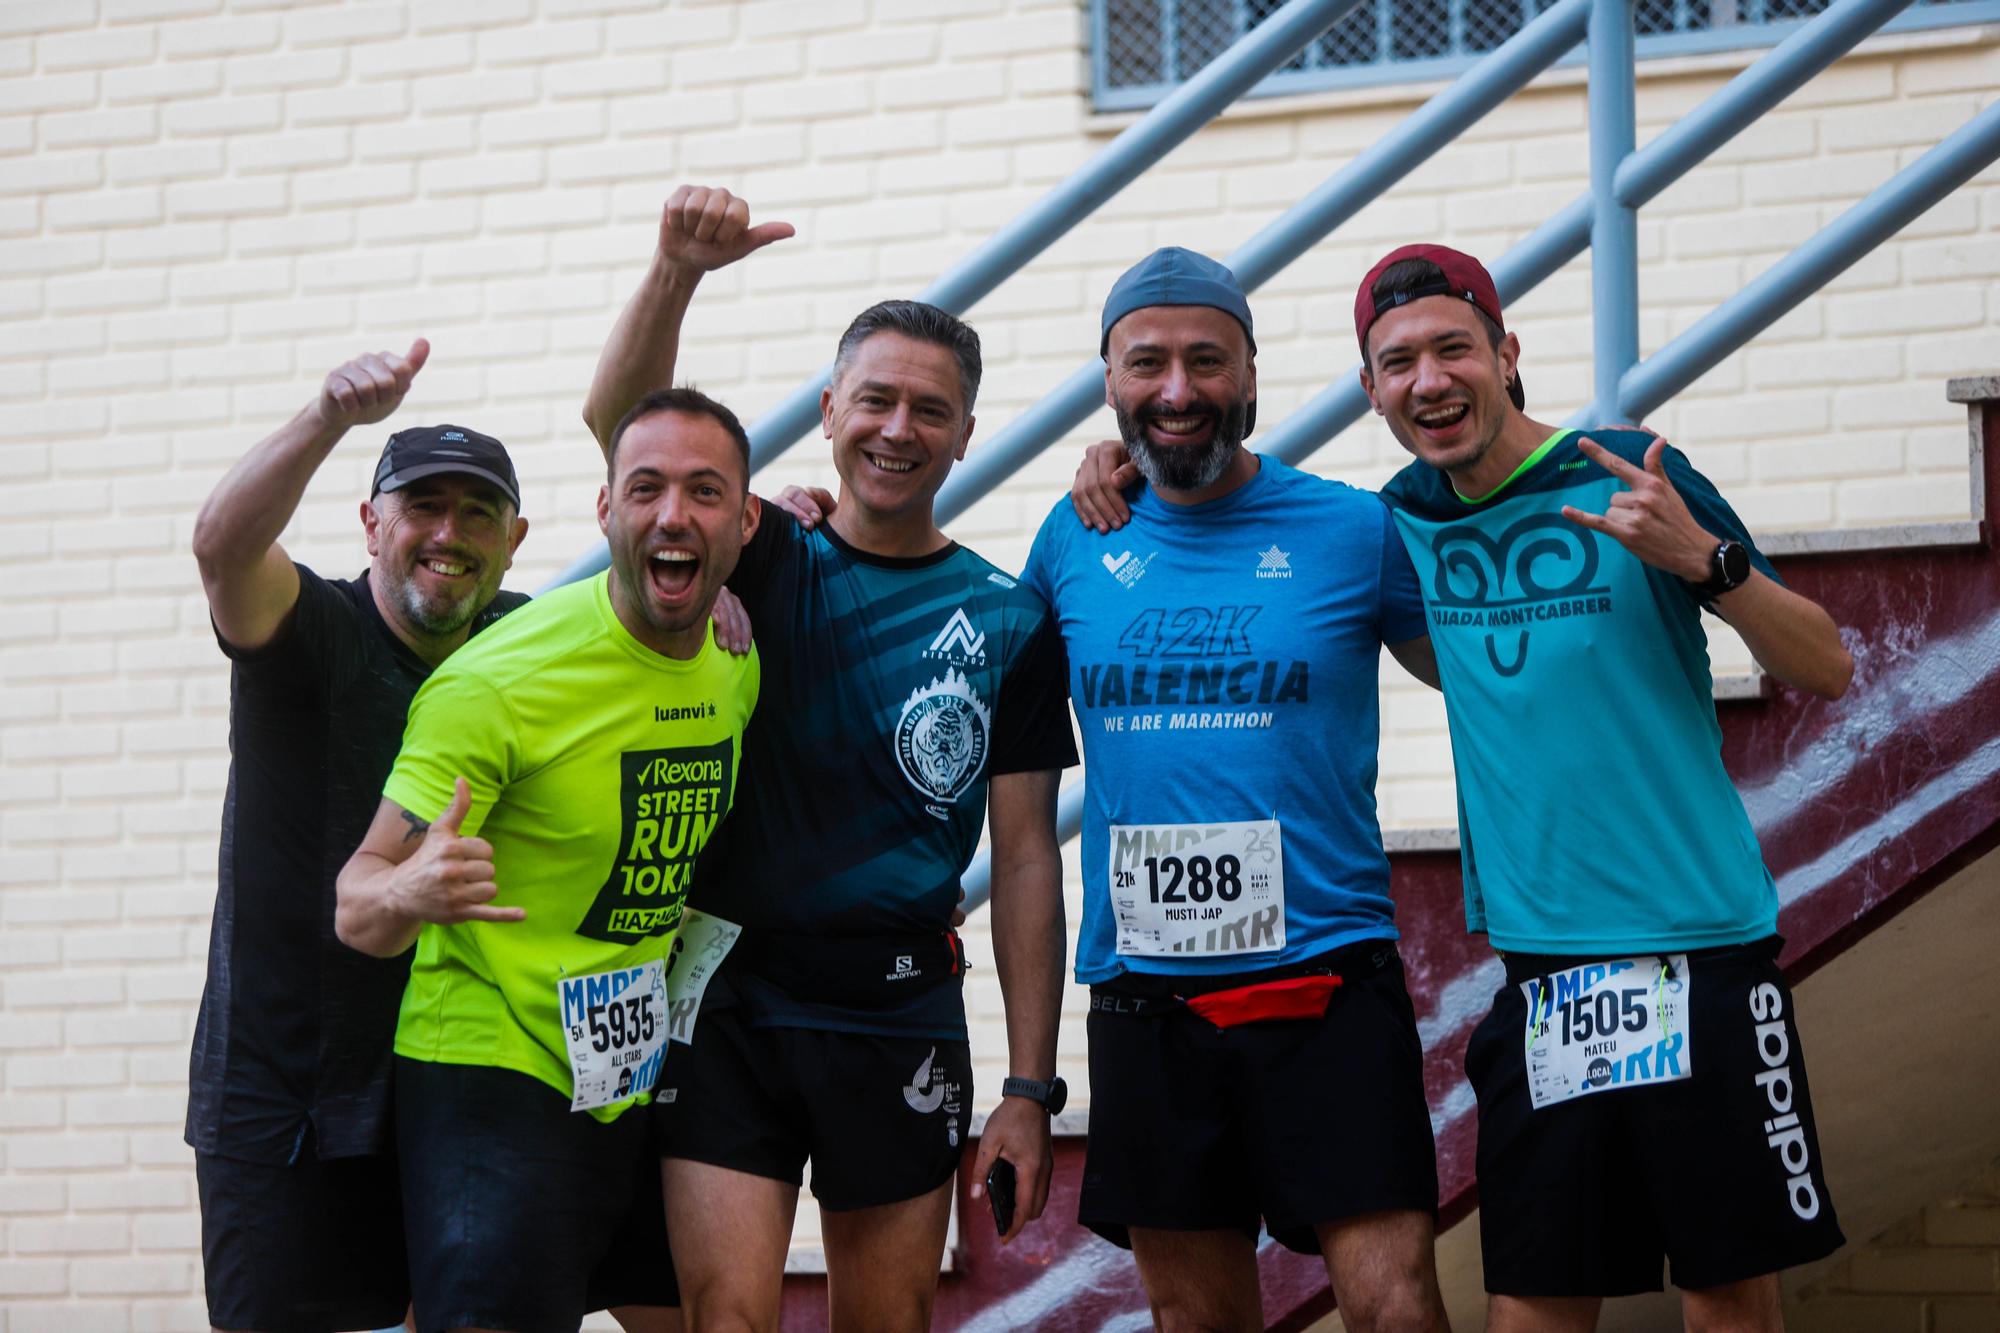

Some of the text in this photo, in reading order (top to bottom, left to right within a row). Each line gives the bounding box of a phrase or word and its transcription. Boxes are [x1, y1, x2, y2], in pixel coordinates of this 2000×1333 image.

[1256, 569, 1292, 579] luanvi
[1487, 597, 1613, 628] MONTCABRER
[1118, 605, 1263, 658] 42K
[1080, 660, 1309, 709] VALENCIA
[654, 702, 705, 722] luanvi
[938, 696, 966, 710] 2022
[1104, 712, 1274, 733] WE ARE MARATHON
[653, 756, 722, 786] Rexona
[637, 787, 721, 818] STREET
[1144, 854, 1242, 903] 1288
[1165, 907, 1222, 921] MUSTI JAP
[587, 994, 655, 1053] 5935
[1558, 988, 1648, 1046] 1505
[612, 1050, 642, 1068] ALL STARS
[1584, 1040, 1617, 1058] MATEU
[1587, 1066, 1612, 1080] LOCAL
[1749, 982, 1819, 1220] adidas
